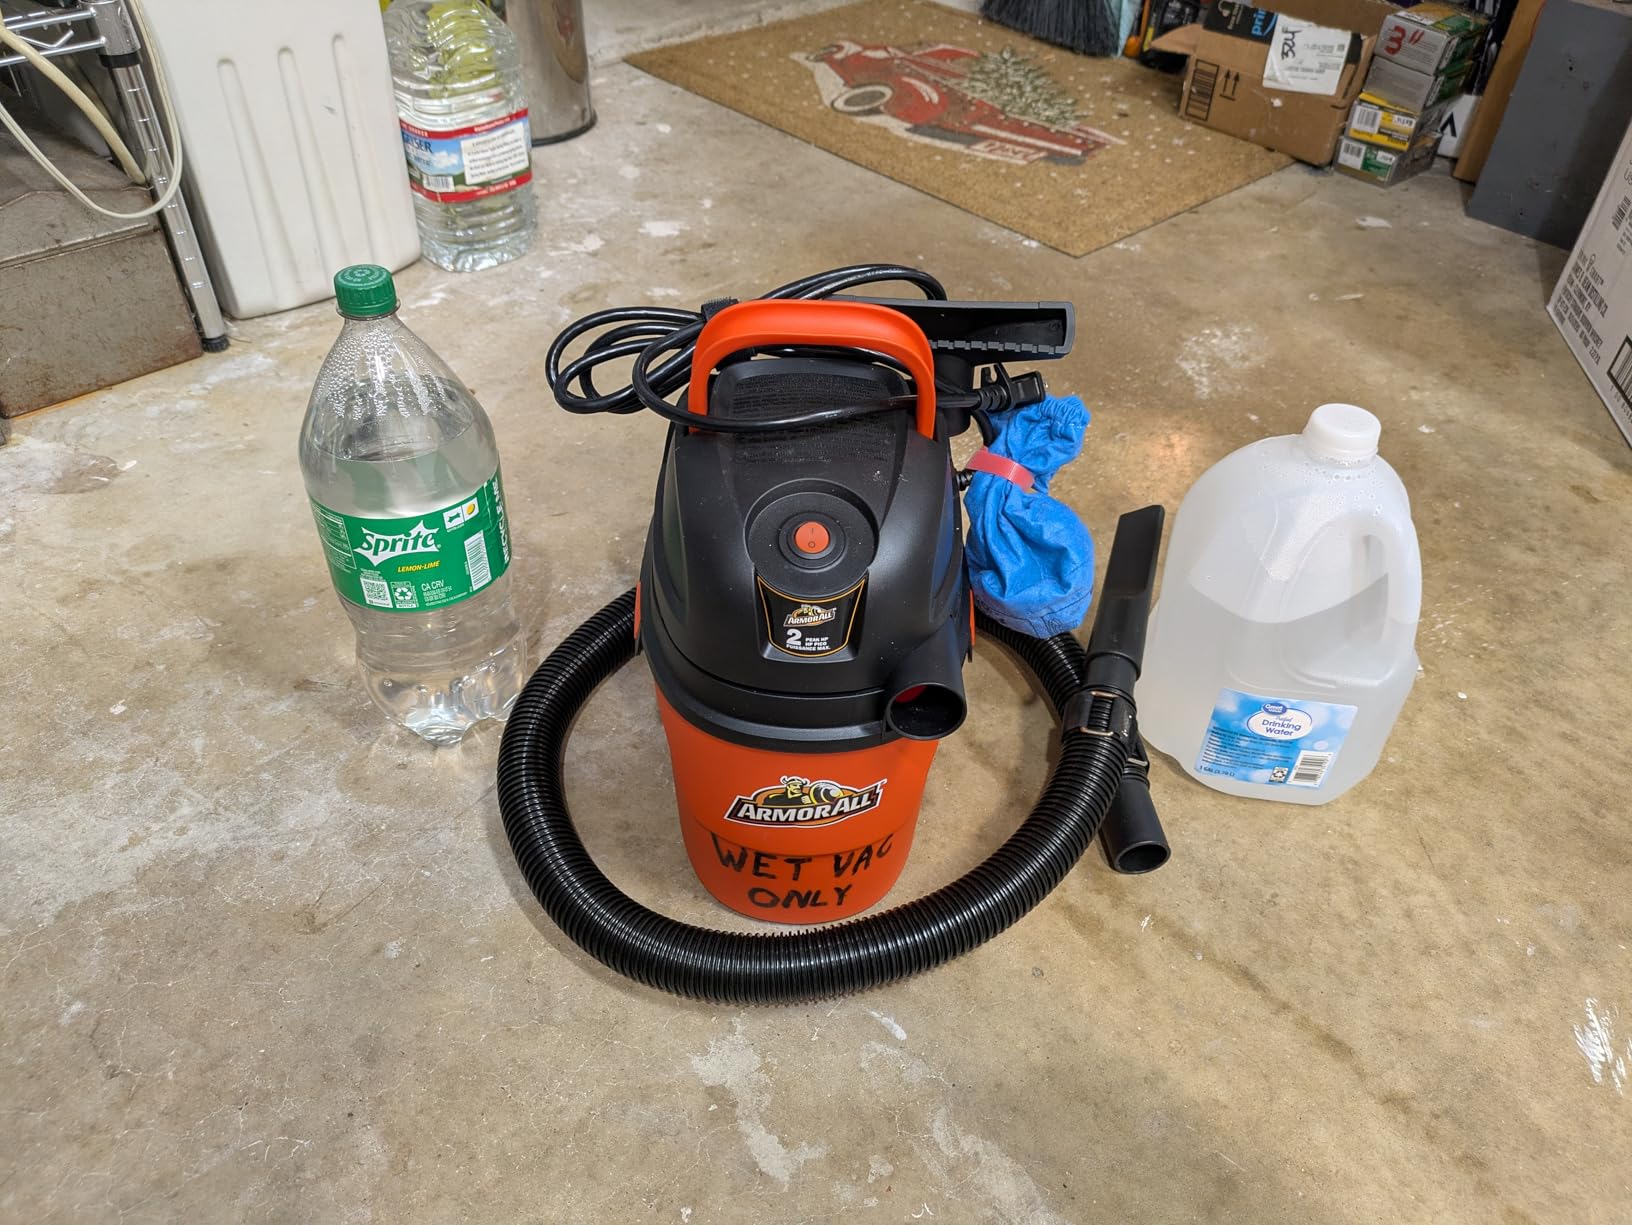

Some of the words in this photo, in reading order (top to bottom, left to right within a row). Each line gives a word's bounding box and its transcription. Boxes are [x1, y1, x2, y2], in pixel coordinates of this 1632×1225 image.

[360, 531, 436, 556] Sprite
[397, 560, 441, 572] LEMON-LIME
[421, 583, 431, 591] CA
[431, 580, 445, 590] CRV
[786, 629, 802, 646] 2
[1262, 719, 1302, 731] Drinking
[1265, 727, 1294, 736] Water
[710, 831, 813, 881] WET
[833, 832, 894, 876] VAC
[747, 883, 853, 909] ONLY
